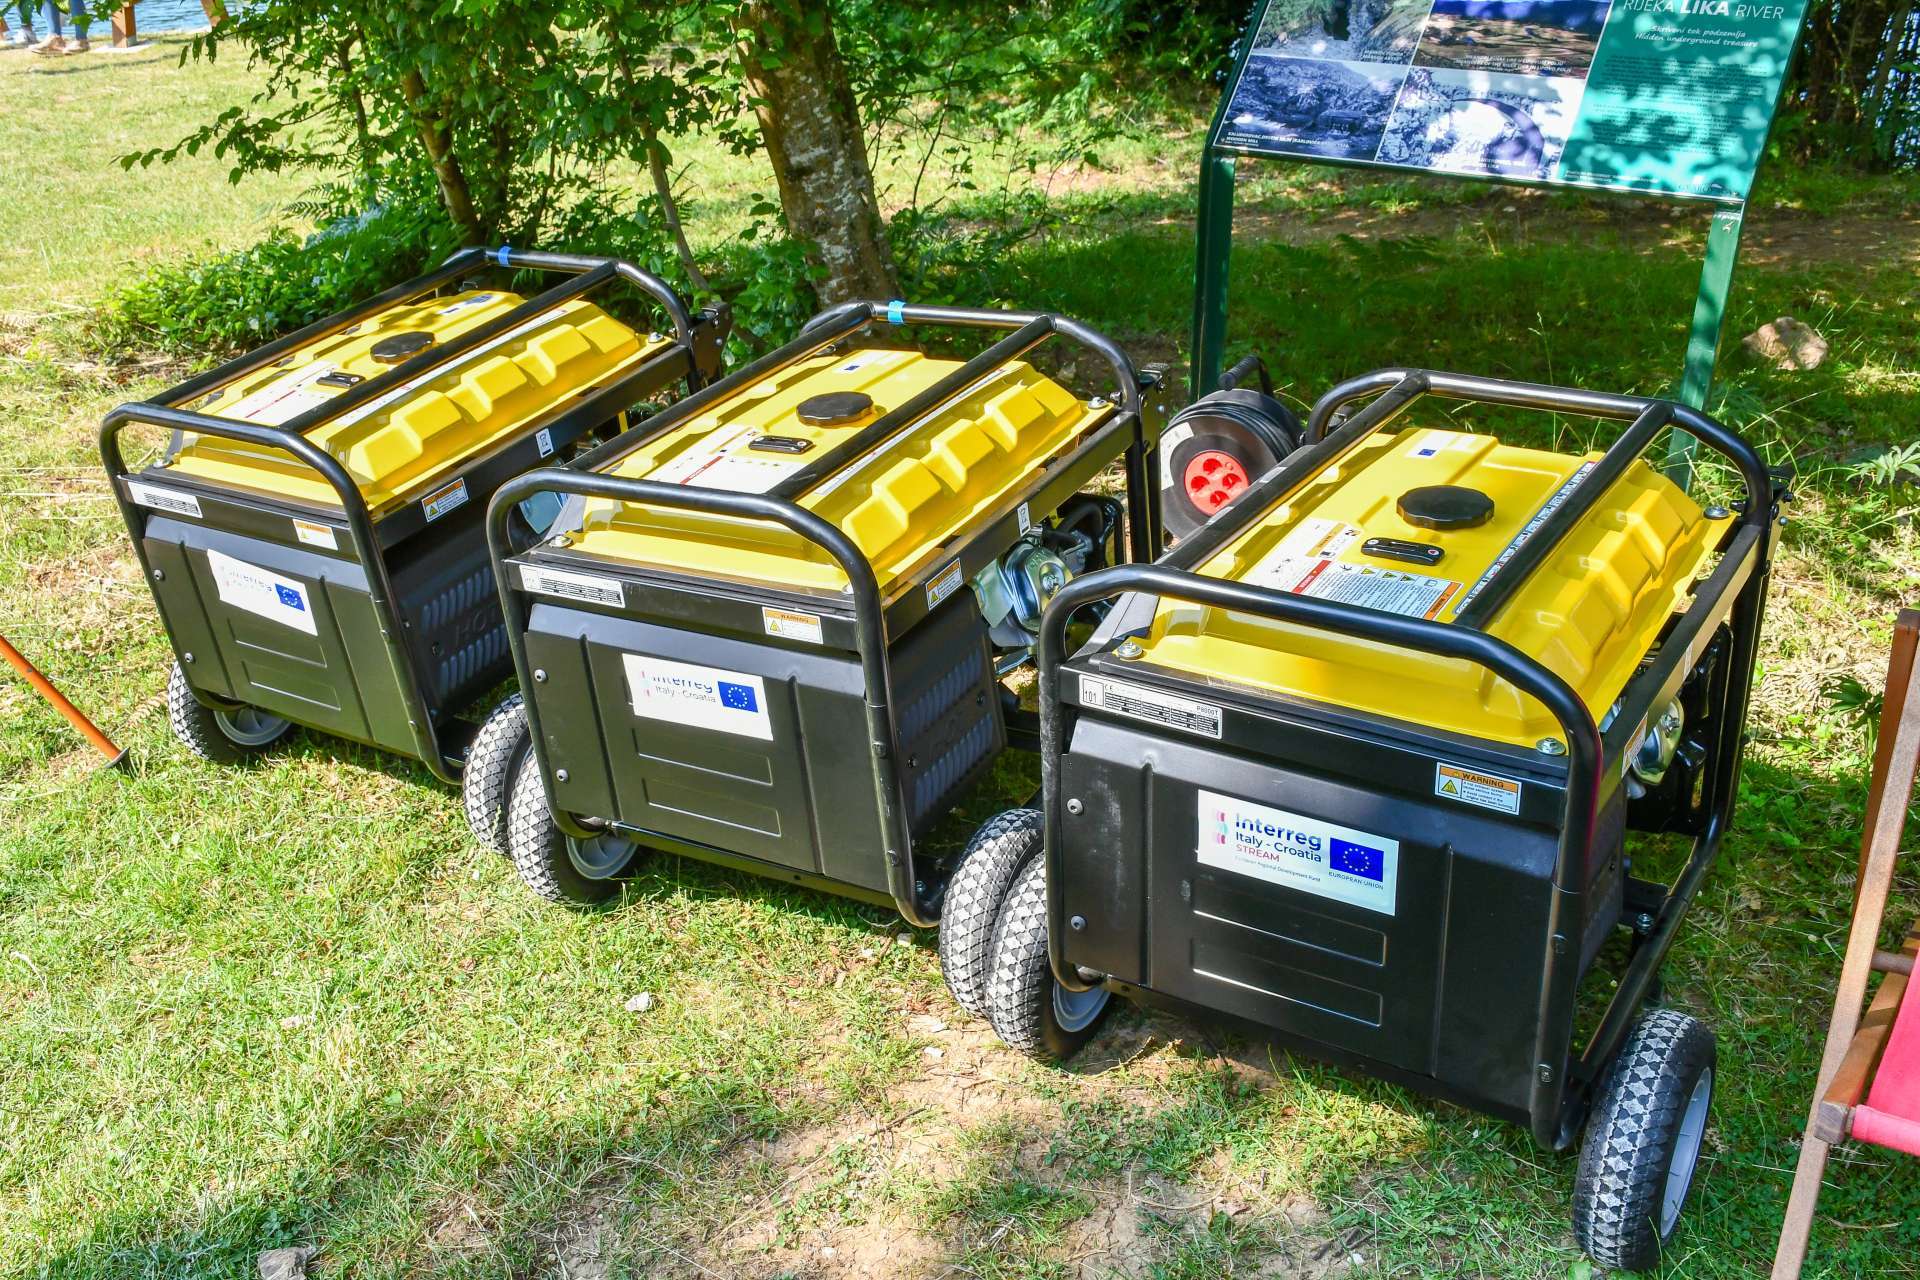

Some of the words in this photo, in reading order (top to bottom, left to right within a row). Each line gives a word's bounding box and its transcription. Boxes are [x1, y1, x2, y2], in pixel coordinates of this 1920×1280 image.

[1623, 0, 1674, 12] RIJEKA
[1680, 0, 1729, 16] LIKA
[1736, 4, 1785, 19] RIVER
[1635, 32, 1664, 41] Hidden
[1666, 35, 1720, 46] underground
[655, 685, 675, 696] Italy
[682, 689, 716, 703] Croatia
[1462, 773, 1504, 788] WARNING
[1236, 832, 1263, 848] Italy
[1274, 842, 1322, 863] Croatia
[1236, 844, 1280, 862] STREAM
[1328, 871, 1361, 884] EUROPEAN
[1363, 880, 1384, 890] UNION
